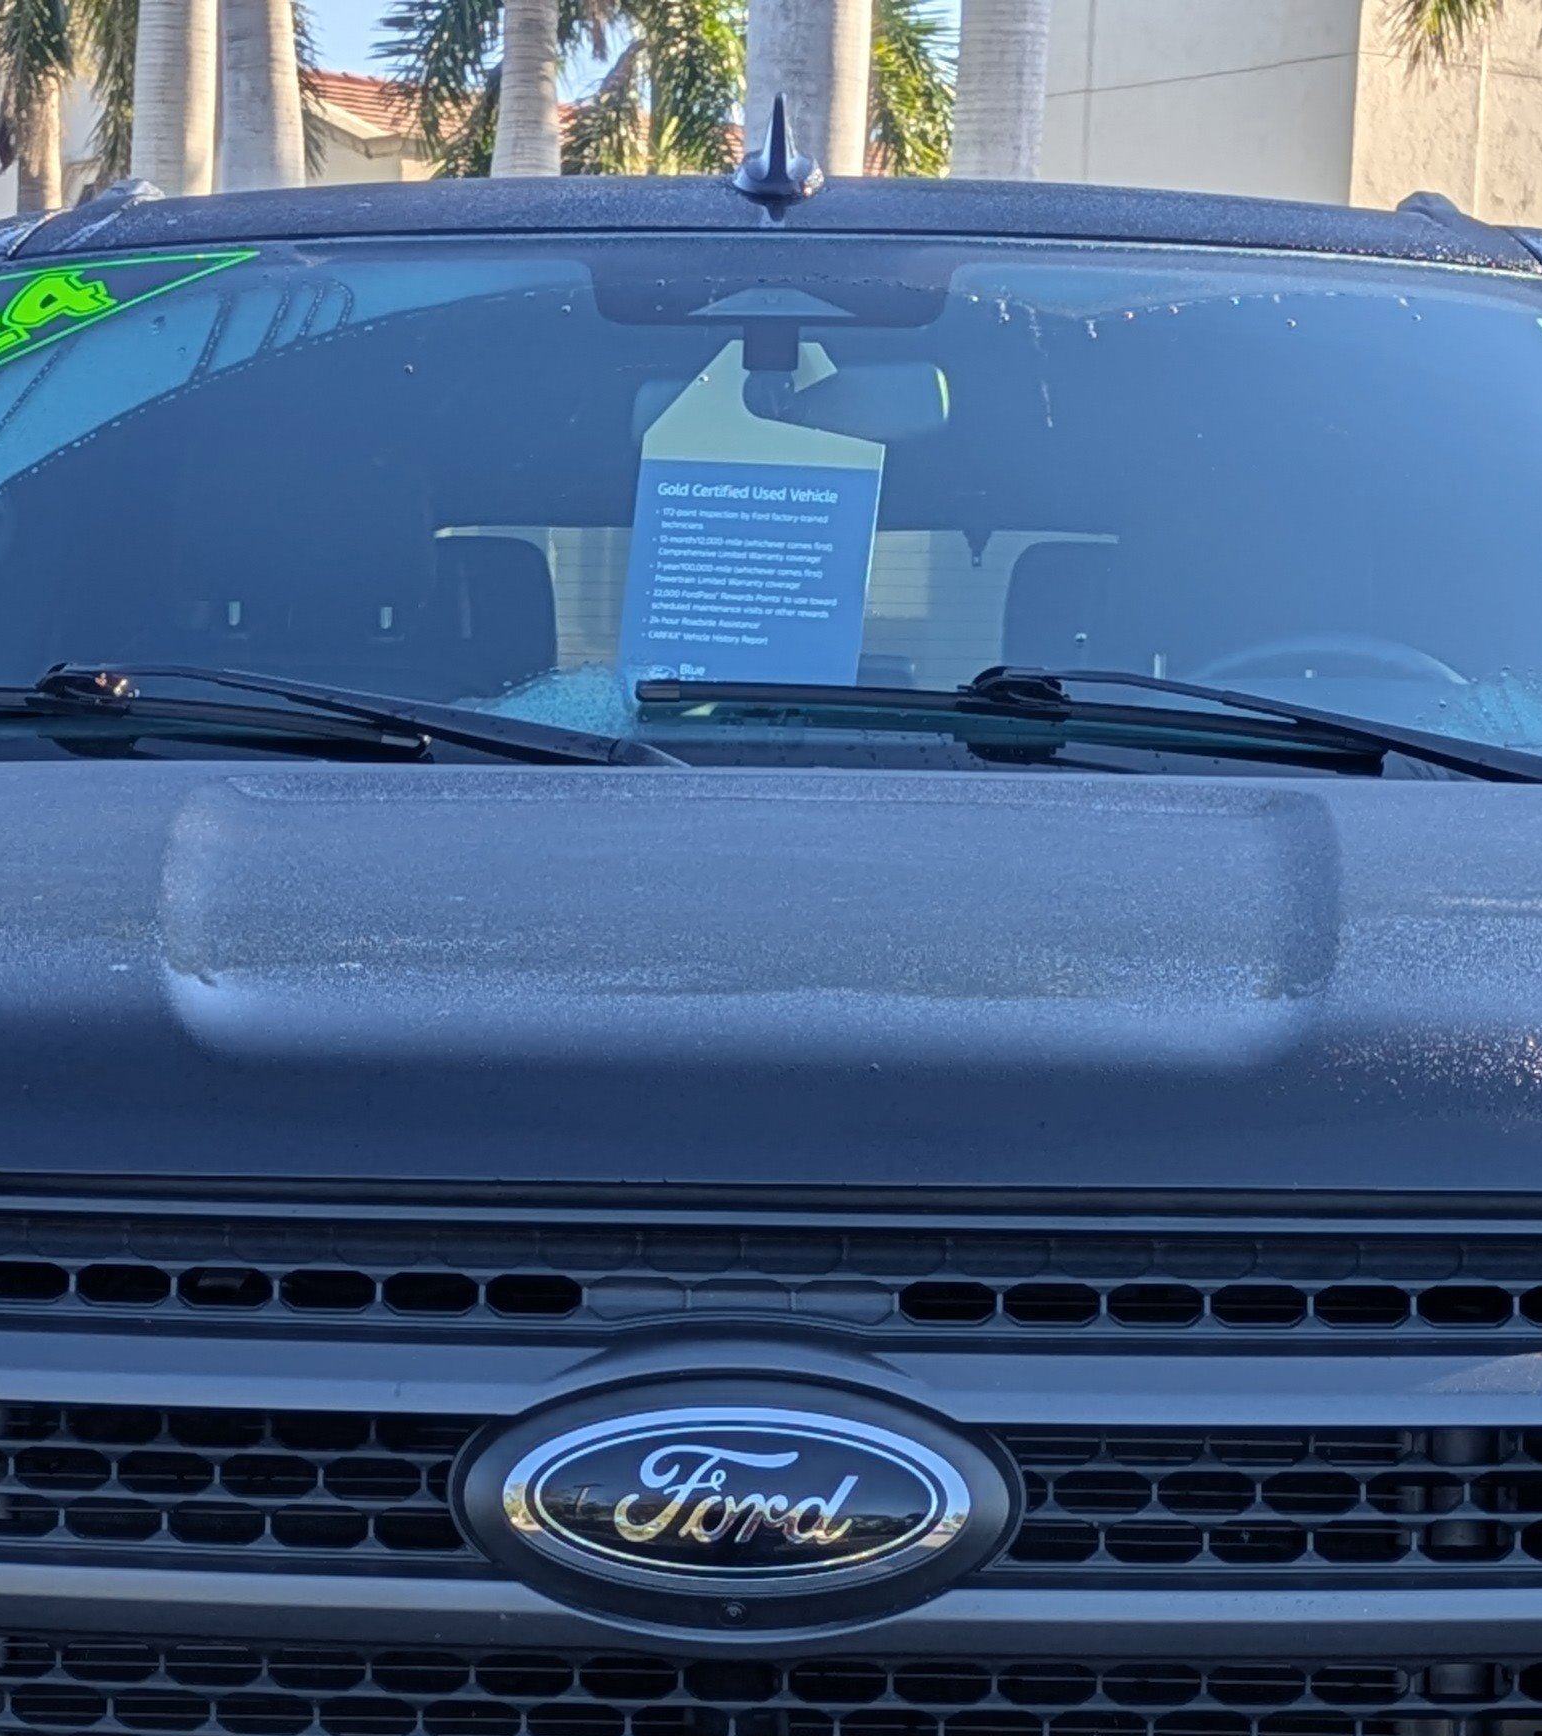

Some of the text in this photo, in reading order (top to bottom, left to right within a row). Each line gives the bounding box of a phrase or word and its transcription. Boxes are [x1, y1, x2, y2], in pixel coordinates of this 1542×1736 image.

[657, 482, 838, 503] Gold Certified Used Vehicle
[679, 663, 706, 676] Blue
[613, 1443, 859, 1544] Ford
